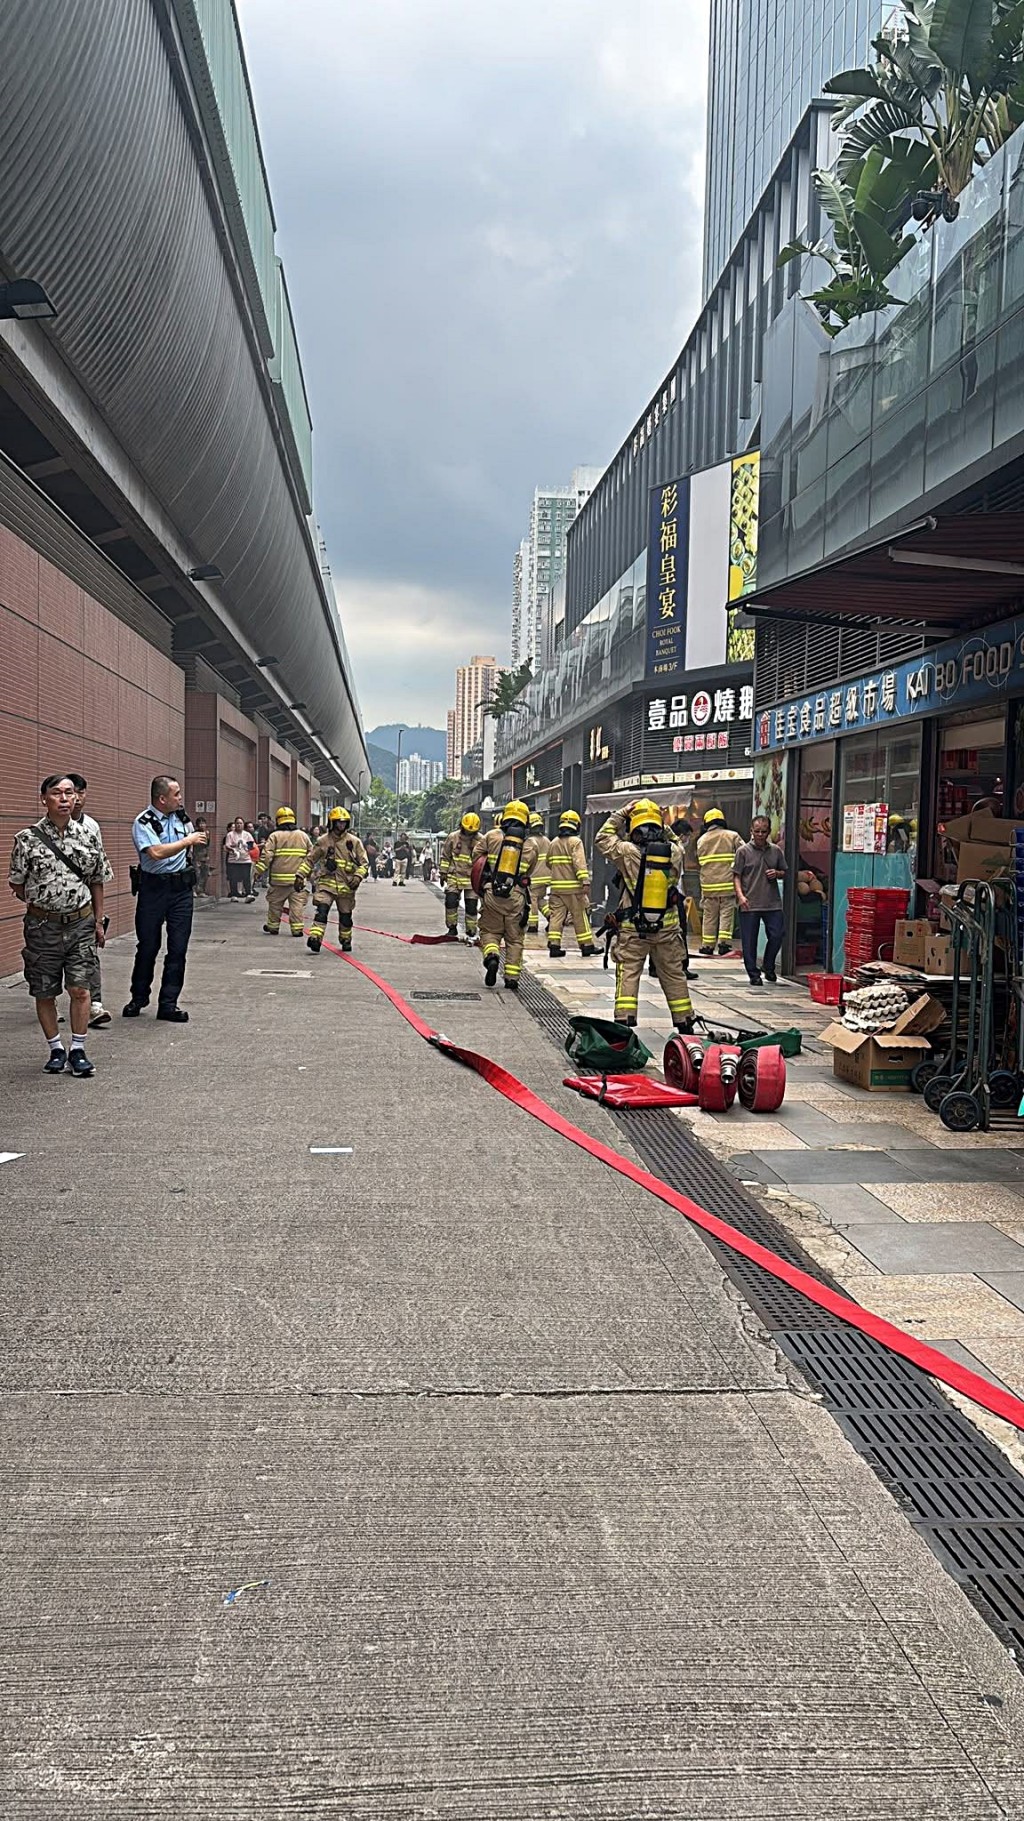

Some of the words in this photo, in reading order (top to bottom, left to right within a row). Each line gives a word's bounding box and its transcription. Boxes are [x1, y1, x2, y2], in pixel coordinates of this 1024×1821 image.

[658, 484, 678, 620] 彩福皇宴
[652, 629, 666, 638] CHOI
[666, 626, 682, 635] FOOK
[906, 667, 929, 700] KAI
[935, 660, 956, 691] BO
[962, 642, 1012, 684] FOOD
[647, 695, 689, 731] 壹品
